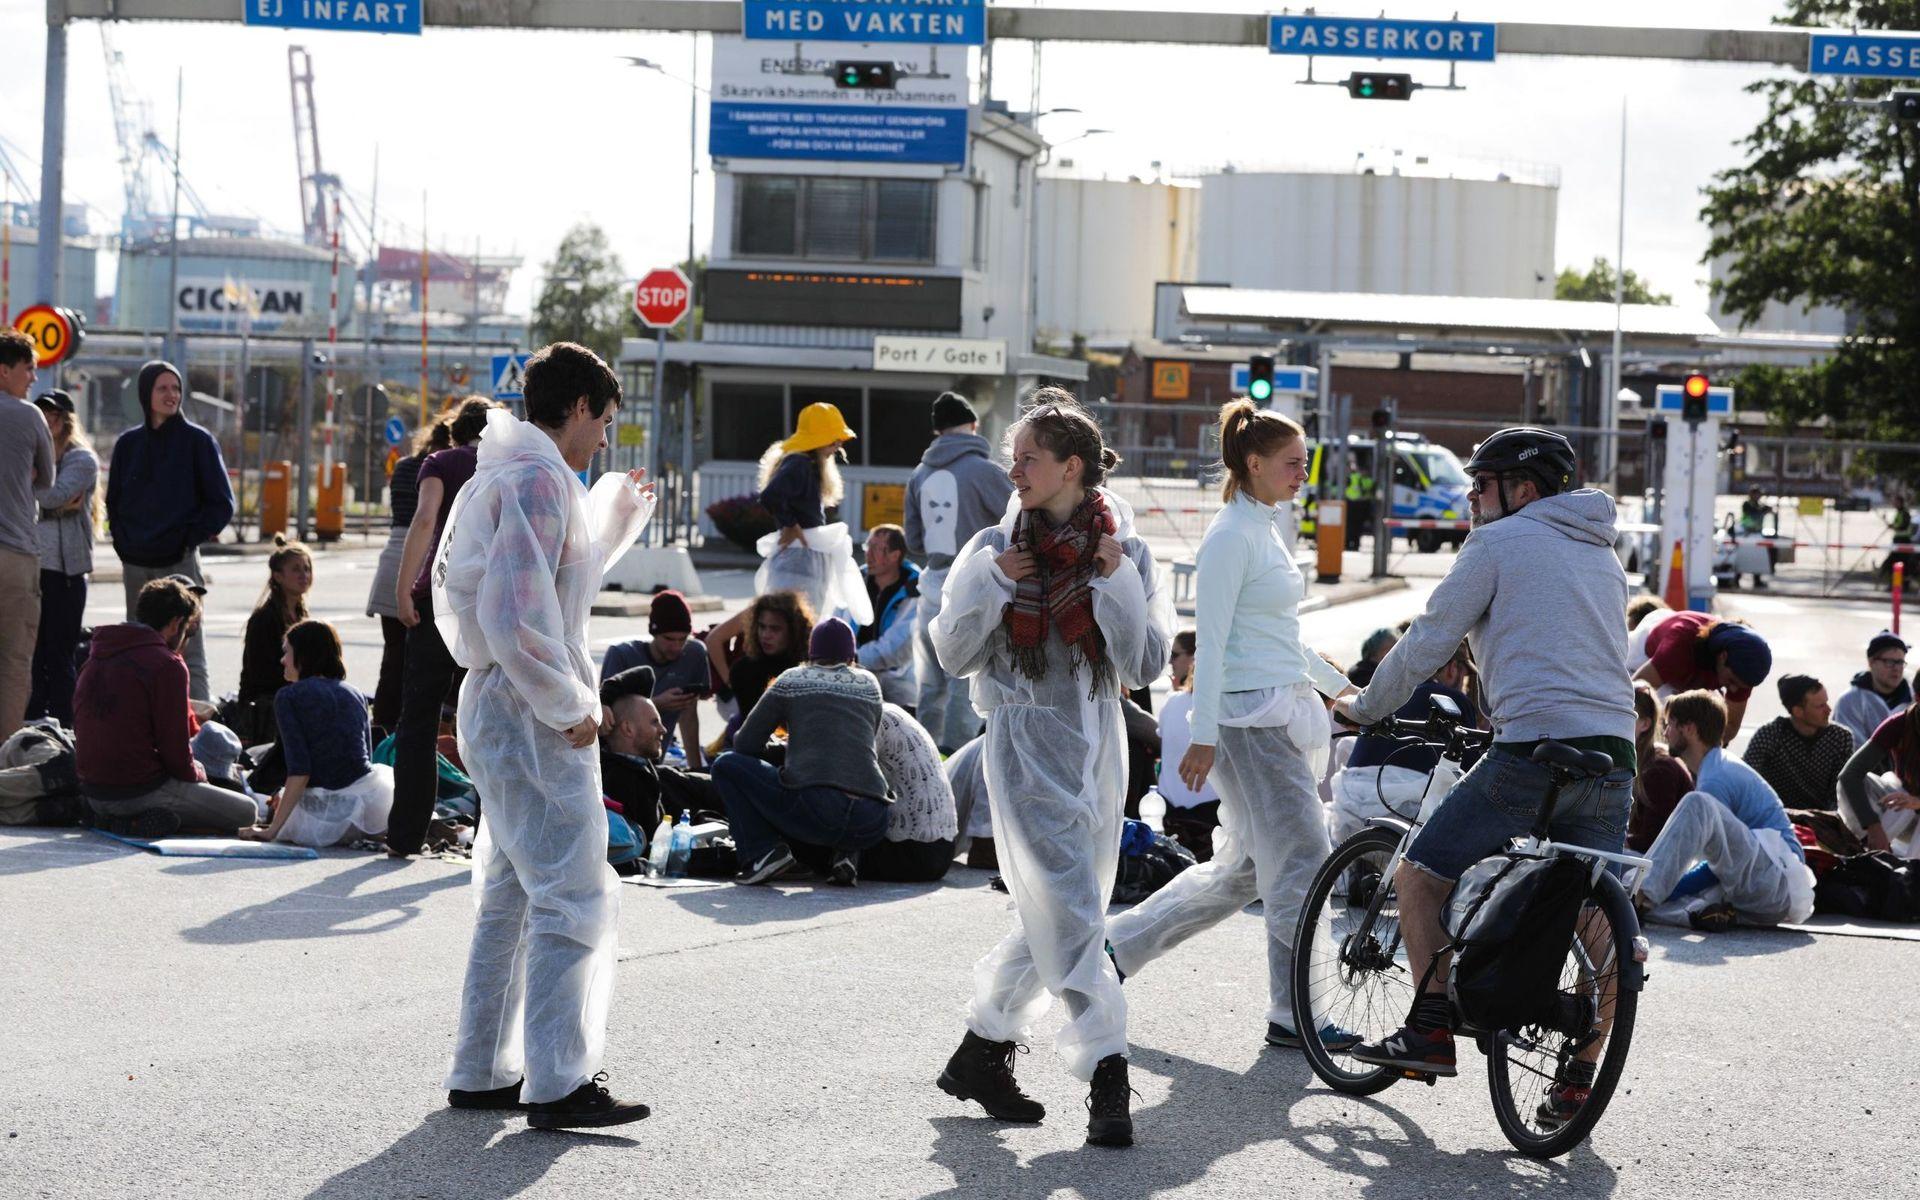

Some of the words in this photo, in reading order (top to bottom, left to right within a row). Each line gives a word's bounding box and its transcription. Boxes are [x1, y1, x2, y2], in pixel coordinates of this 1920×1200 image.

[258, 0, 283, 17] EJ
[303, 0, 407, 24] INFART
[766, 10, 824, 31] MED
[844, 12, 964, 35] VAKTEN
[1281, 25, 1483, 52] PASSERKORT
[1822, 44, 1920, 68] PASSE
[720, 84, 849, 100] Skarvikshamnen
[864, 88, 956, 104] Ryahamnen
[179, 286, 303, 314] CICAN
[638, 287, 686, 307] STOP
[880, 345, 917, 361] Port
[926, 348, 936, 362] /
[944, 347, 987, 364] Gate
